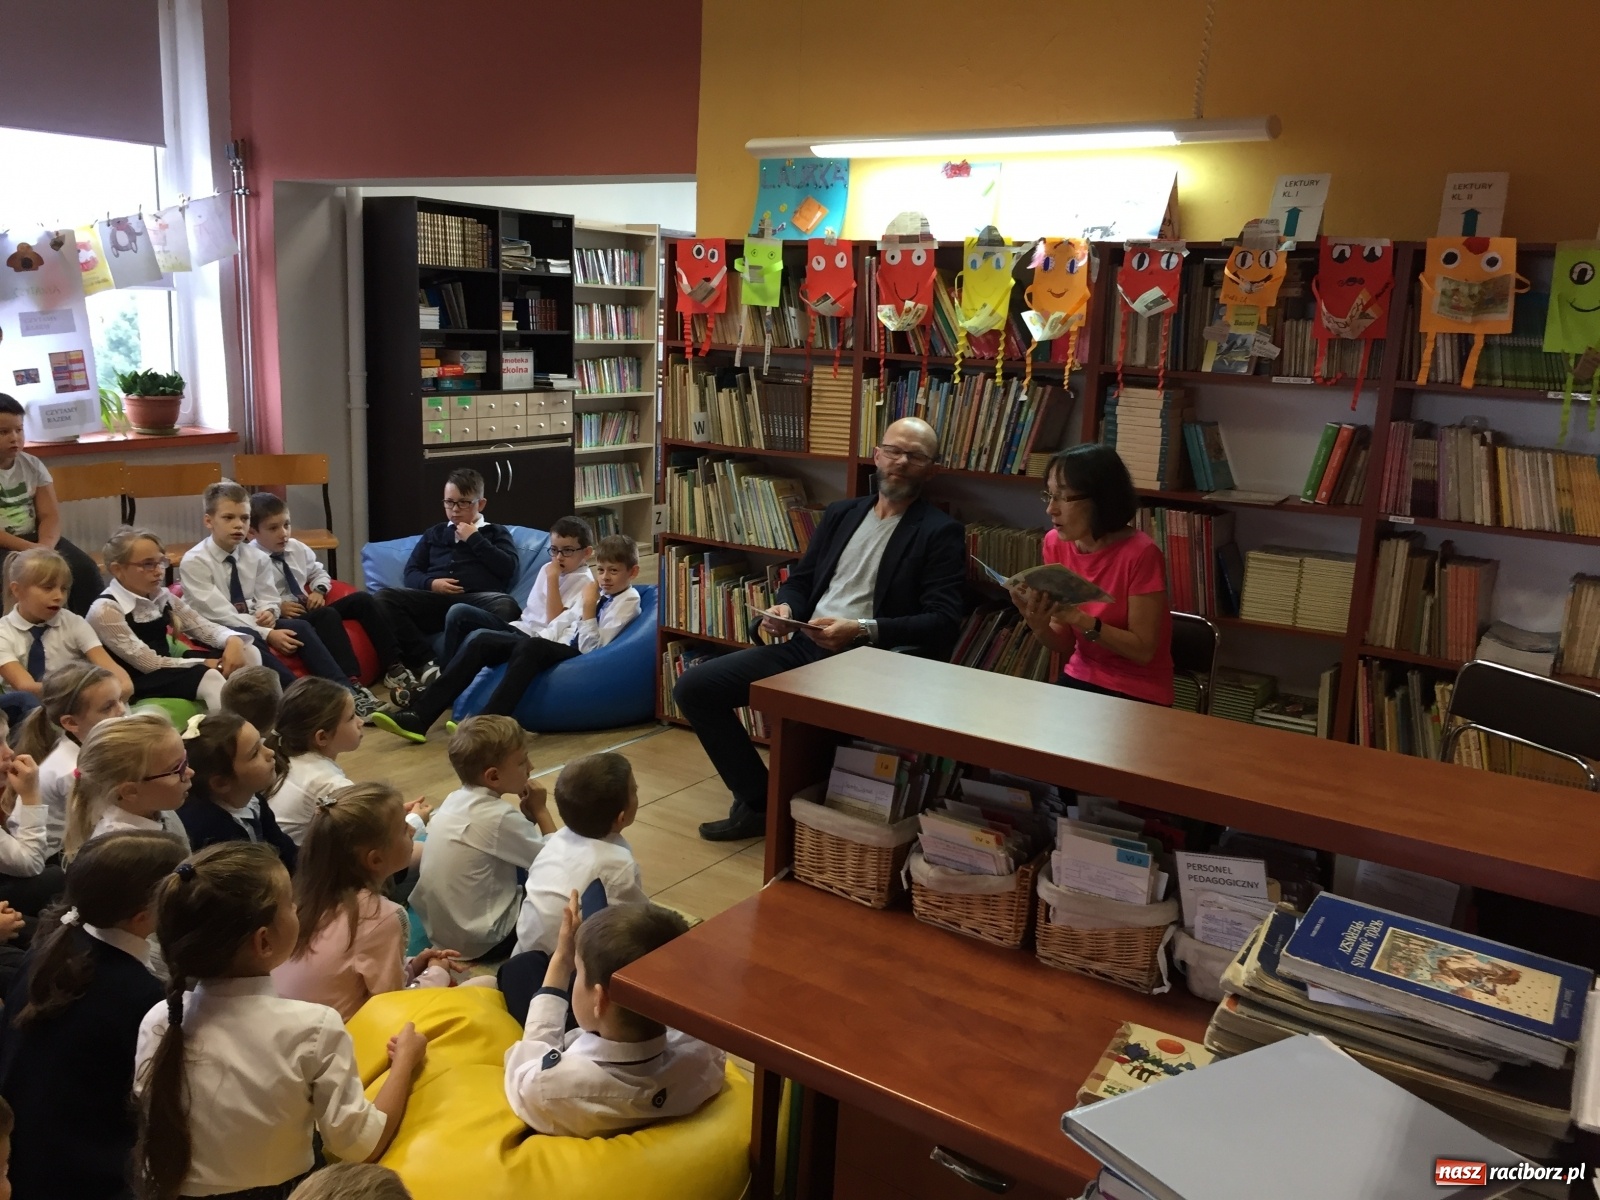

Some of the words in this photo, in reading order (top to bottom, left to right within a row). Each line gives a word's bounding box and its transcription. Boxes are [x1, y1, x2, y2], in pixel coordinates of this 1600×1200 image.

[1285, 180, 1320, 188] LEKTURY
[1452, 182, 1494, 191] LEKTURY
[502, 366, 529, 374] zkolna
[45, 406, 78, 416] CZYTAMY
[694, 421, 705, 435] W
[655, 511, 662, 525] Z
[1186, 862, 1233, 875] PERSONEL
[1187, 874, 1260, 889] PEDAGOGICZNY
[1363, 919, 1385, 939] KRÓL
[1337, 920, 1366, 956] PIERWSZY
[1350, 937, 1375, 969] MACIUŚ
